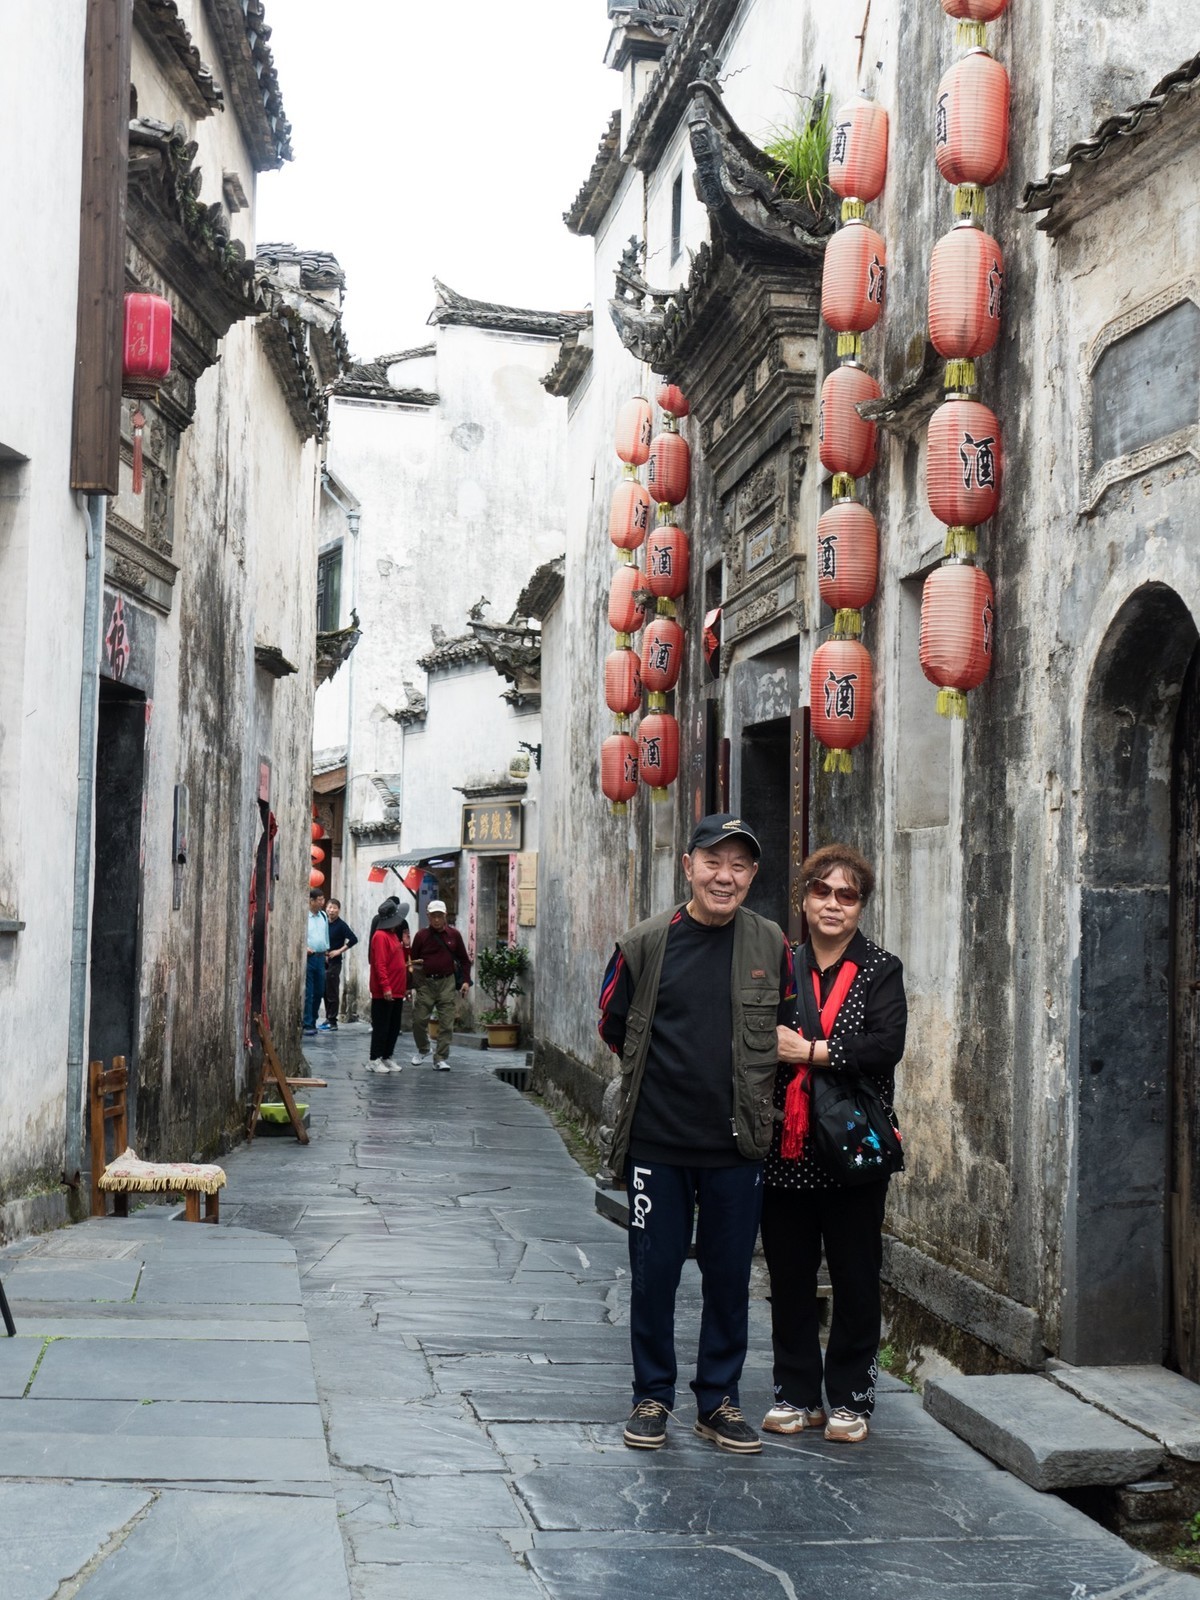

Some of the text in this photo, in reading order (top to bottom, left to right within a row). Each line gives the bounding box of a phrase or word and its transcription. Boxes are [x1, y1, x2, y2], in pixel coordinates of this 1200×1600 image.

[959, 431, 996, 492] 酒
[634, 499, 648, 528] 酒
[651, 544, 673, 577] 酒
[649, 636, 673, 675] 酒
[824, 669, 858, 720] 酒
[625, 753, 638, 783] 酒
[641, 736, 661, 769] 酒
[633, 1166, 652, 1190] Le
[632, 1193, 652, 1229] Coq
